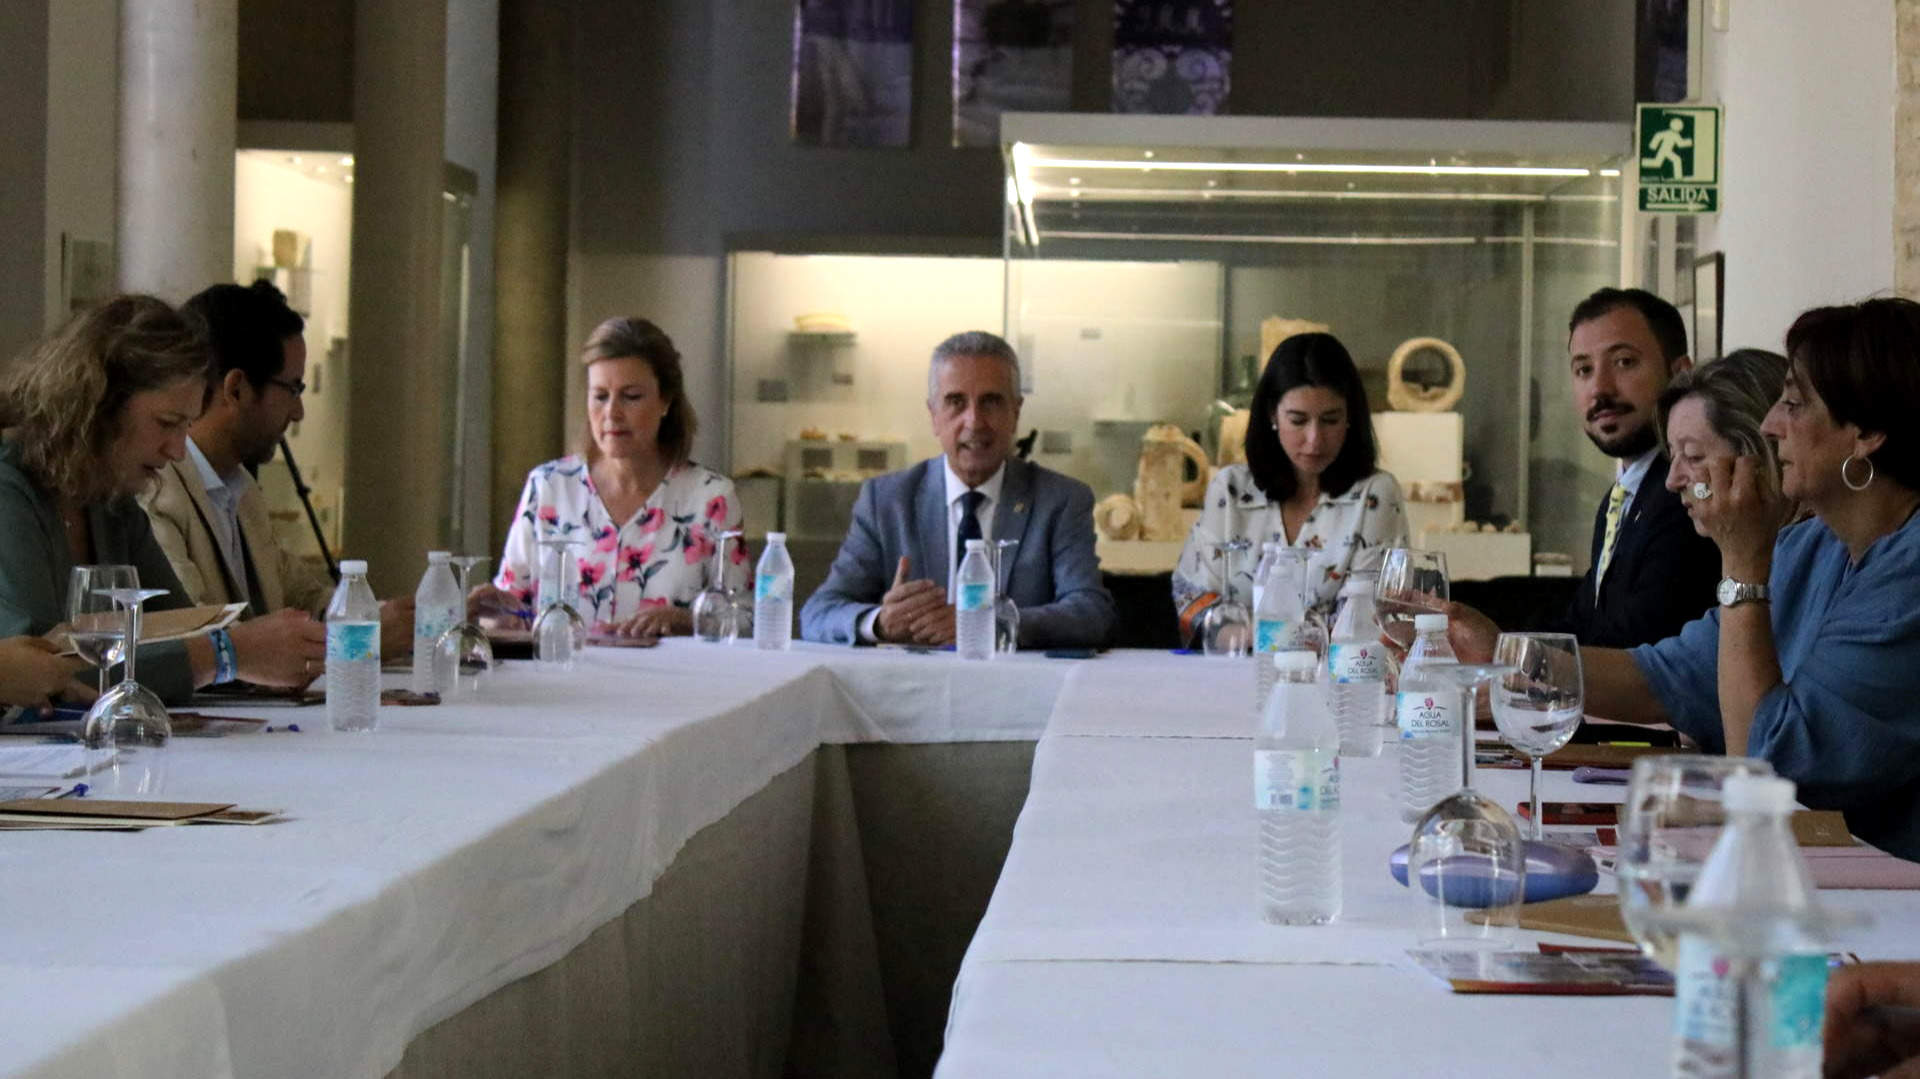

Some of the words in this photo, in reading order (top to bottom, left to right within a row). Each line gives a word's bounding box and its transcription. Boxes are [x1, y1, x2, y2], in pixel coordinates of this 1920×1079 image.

[1647, 185, 1710, 201] SALIDA
[1419, 711, 1441, 719] AGUA
[1411, 720, 1425, 728] DEL
[1425, 720, 1450, 728] ROSAL
